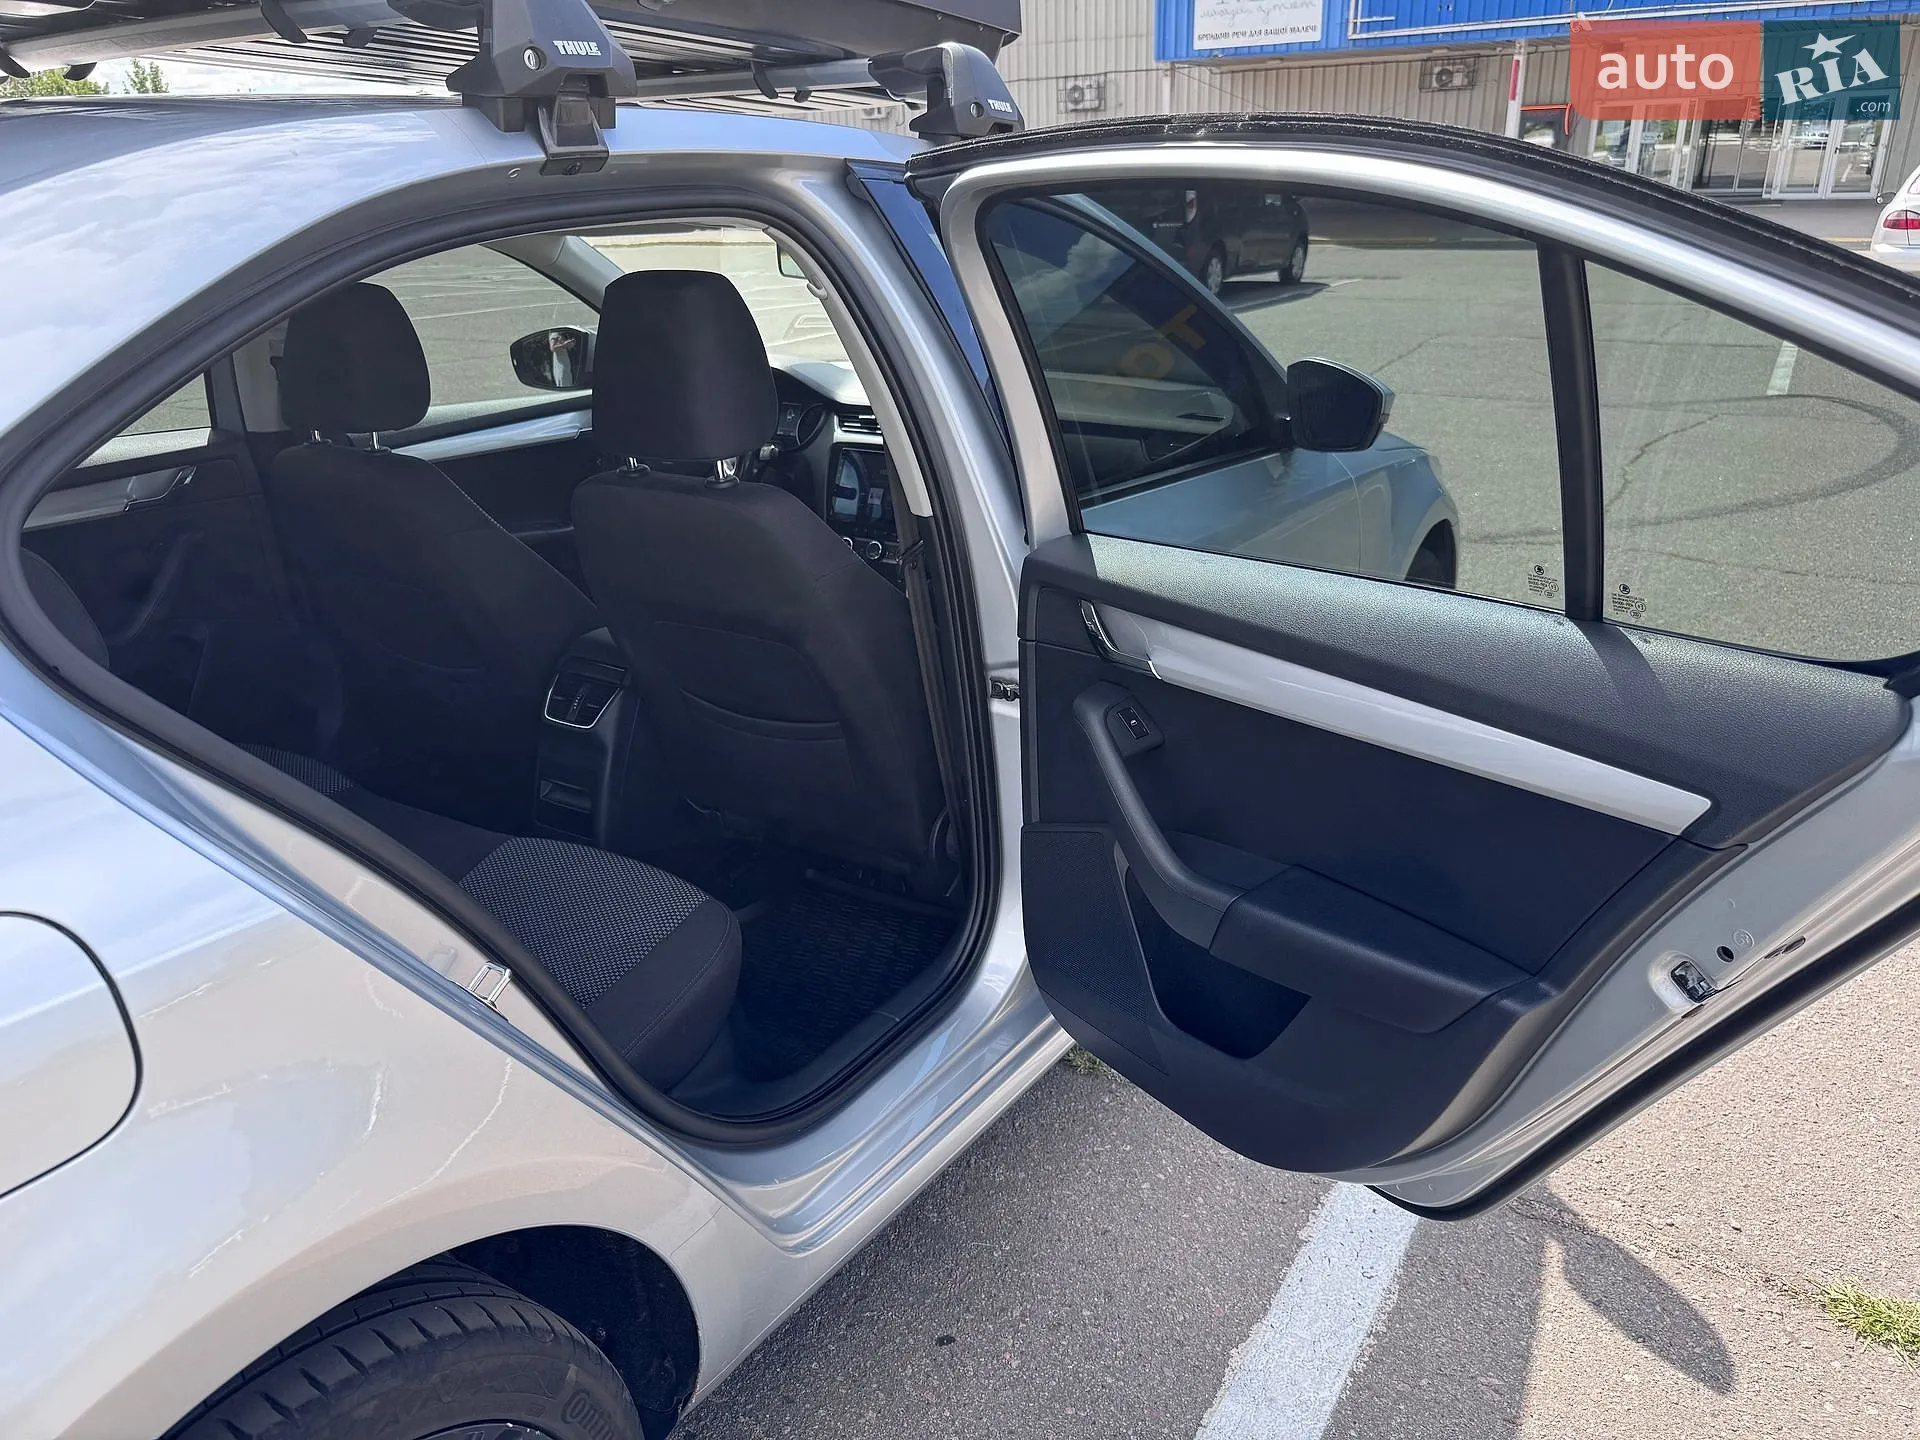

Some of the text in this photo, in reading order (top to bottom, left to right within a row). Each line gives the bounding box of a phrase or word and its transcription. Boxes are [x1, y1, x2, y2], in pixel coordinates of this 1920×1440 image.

[1248, 28, 1262, 38] ДЛЯ
[552, 40, 602, 56] THULE
[986, 98, 1013, 113] THULE
